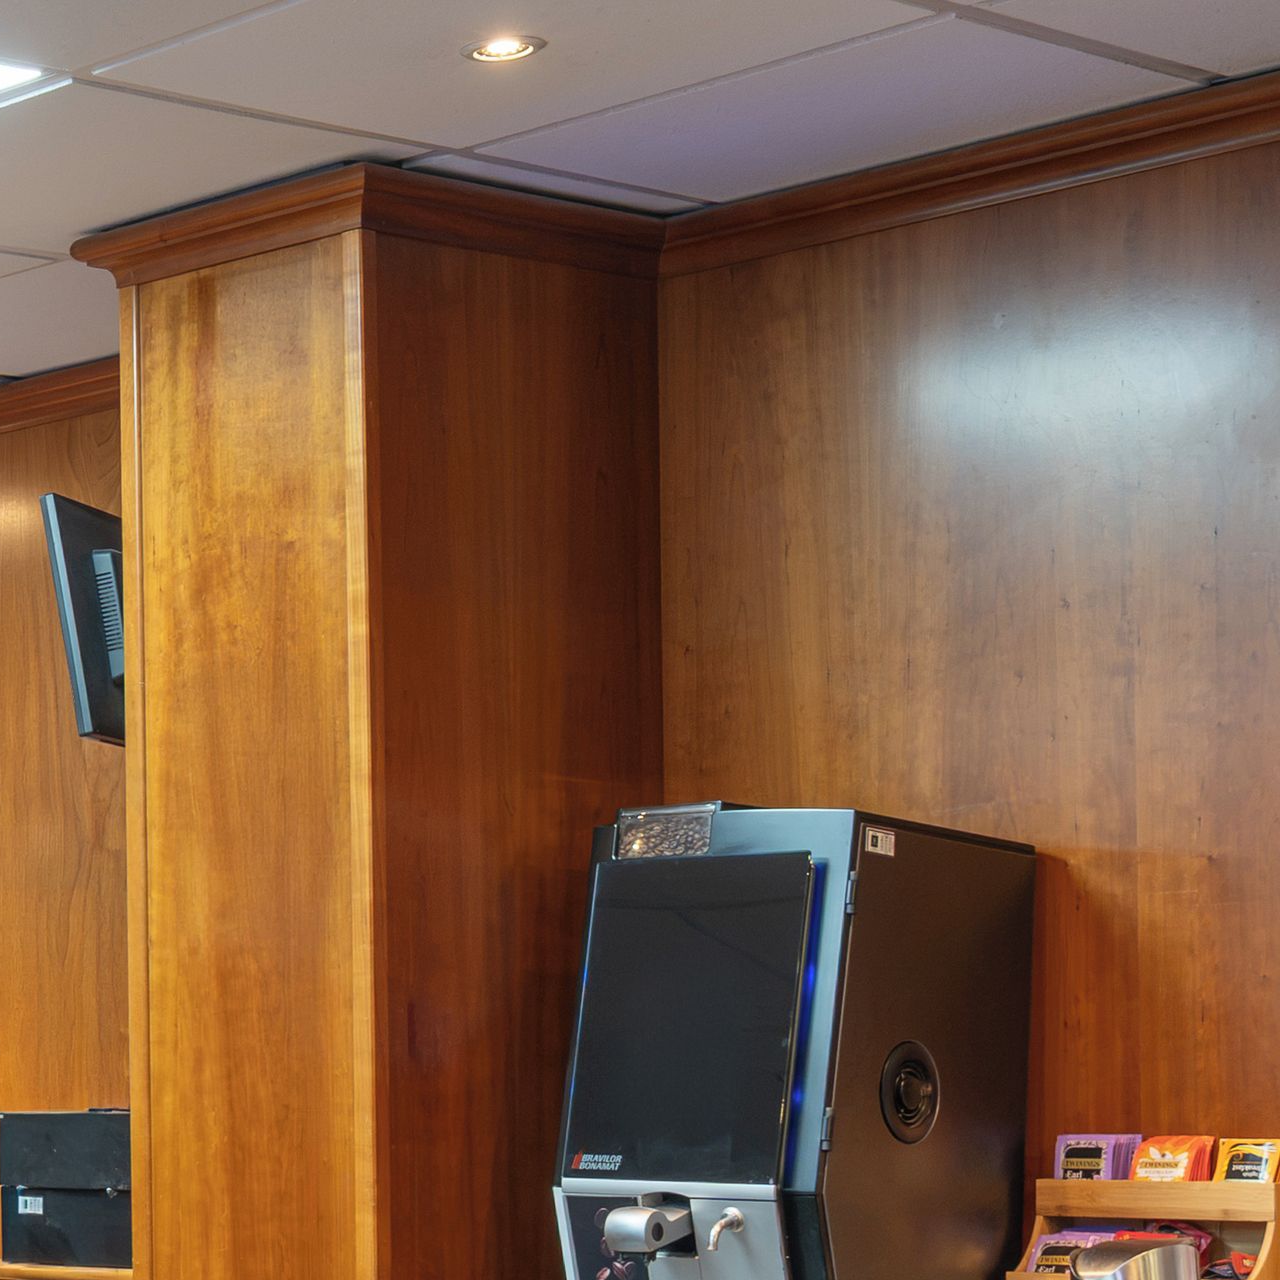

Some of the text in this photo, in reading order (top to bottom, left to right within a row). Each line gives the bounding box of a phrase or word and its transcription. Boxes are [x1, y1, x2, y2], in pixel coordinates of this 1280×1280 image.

[582, 1154, 622, 1162] BRAVILOR
[580, 1162, 620, 1170] BONAMAT
[1065, 1170, 1082, 1178] Earl
